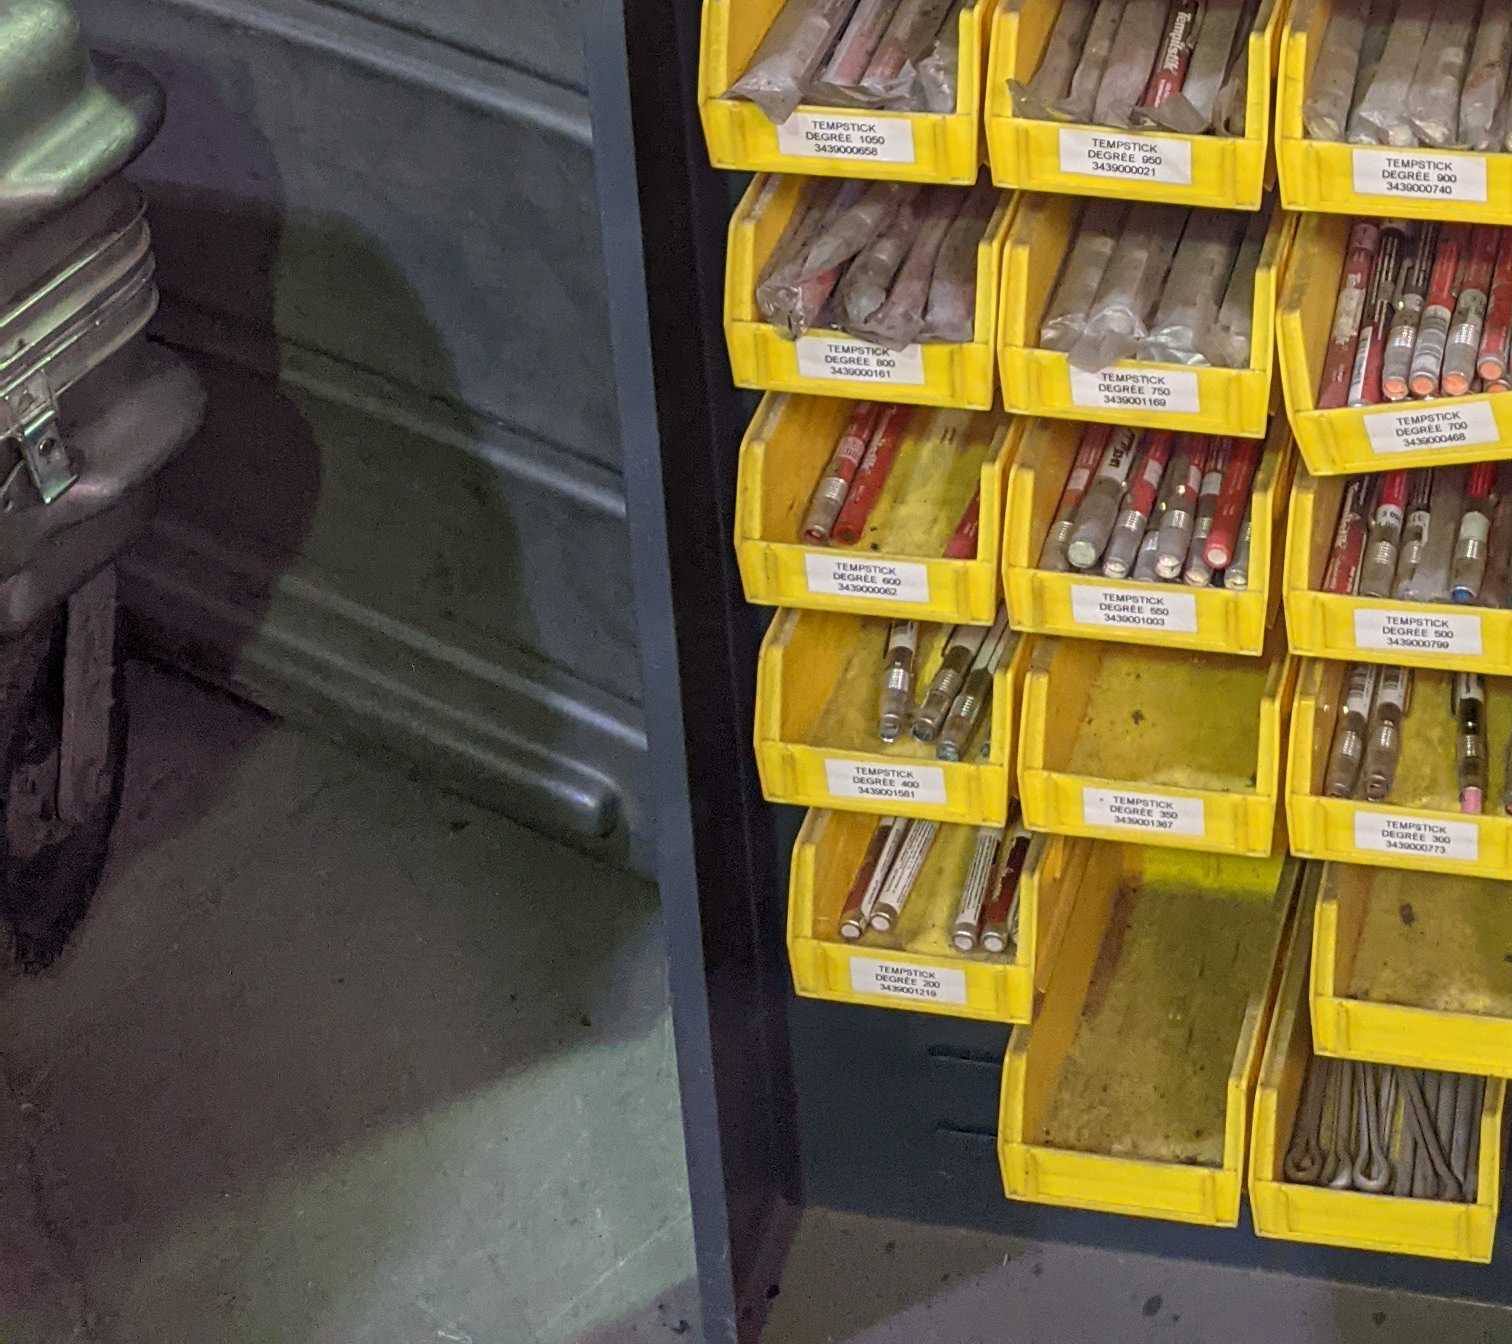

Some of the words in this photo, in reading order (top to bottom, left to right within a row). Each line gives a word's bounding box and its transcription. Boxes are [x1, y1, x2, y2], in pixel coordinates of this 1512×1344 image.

[811, 121, 876, 133] TEMPSTICK
[860, 134, 885, 145] 1050
[1092, 138, 1158, 153] TEMPSTICK
[1142, 155, 1162, 166] 950
[1386, 158, 1453, 171] TEMPSTICK
[1437, 173, 1457, 183] 900
[827, 344, 890, 356] TEMPSTICK
[876, 358, 896, 368] 800
[1101, 372, 1166, 385] TEMPSTICK
[1151, 387, 1171, 396] 750
[1395, 411, 1461, 427] TEMPSTICK
[1447, 421, 1468, 432] 700
[835, 562, 896, 575] TEMPSTICK
[882, 577, 901, 586] 600
[1102, 592, 1164, 605] TEMPSTICK
[1385, 616, 1449, 628] TEMPSTICK
[1434, 629, 1454, 639] 500
[855, 766, 914, 778] TEMPSTICK
[901, 780, 920, 789] 400
[1113, 795, 1174, 809] TEMPSTICK
[1159, 810, 1178, 819] 350
[1385, 820, 1447, 834] TEMPSTICK
[1432, 834, 1451, 844] 300
[878, 965, 936, 979] TEMPSTICK
[923, 979, 941, 988] 200
